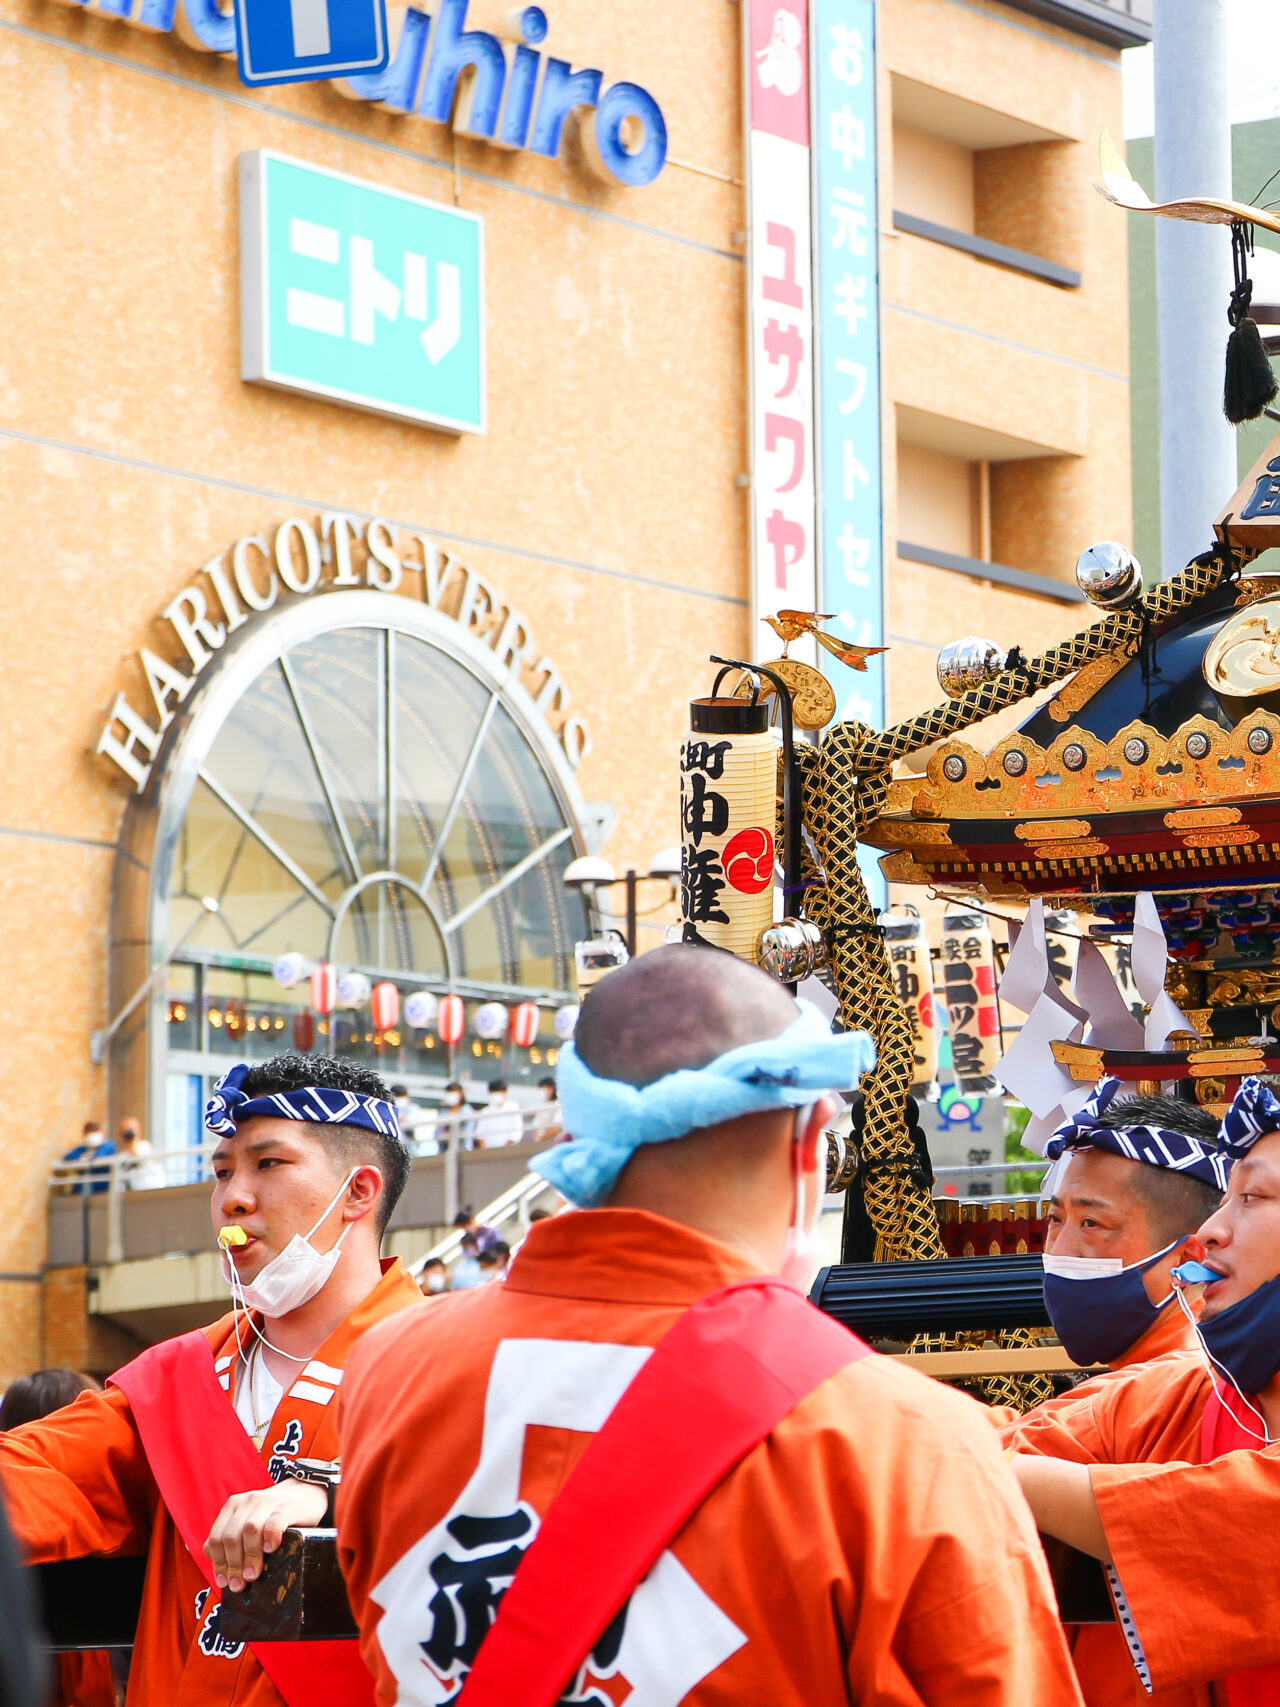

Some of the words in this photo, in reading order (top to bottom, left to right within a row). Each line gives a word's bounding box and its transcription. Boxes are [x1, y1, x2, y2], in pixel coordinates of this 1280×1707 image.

[287, 217, 461, 366] ニトリ
[680, 740, 733, 780] 町
